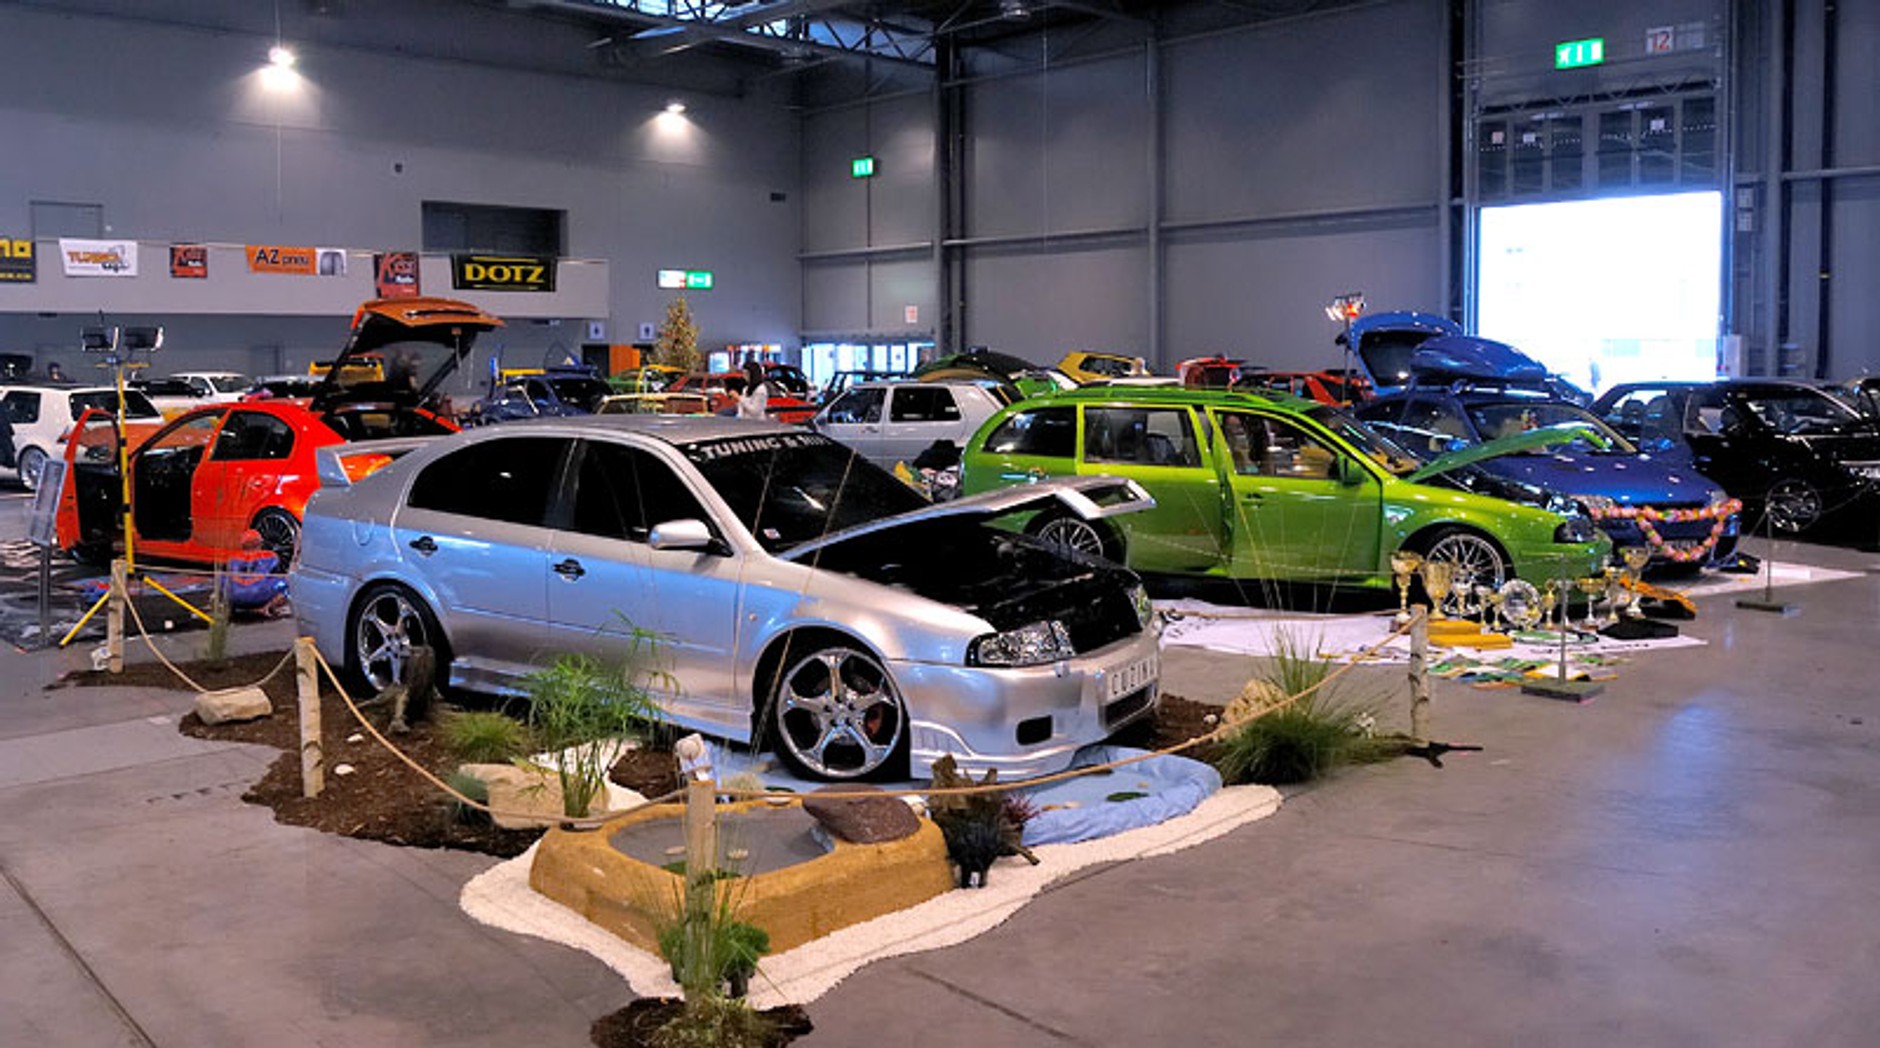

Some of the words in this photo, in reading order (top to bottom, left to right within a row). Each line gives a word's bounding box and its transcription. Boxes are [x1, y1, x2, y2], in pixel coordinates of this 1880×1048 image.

[255, 249, 279, 265] AZ
[464, 263, 544, 283] DOTZ
[701, 436, 782, 460] TUNING
